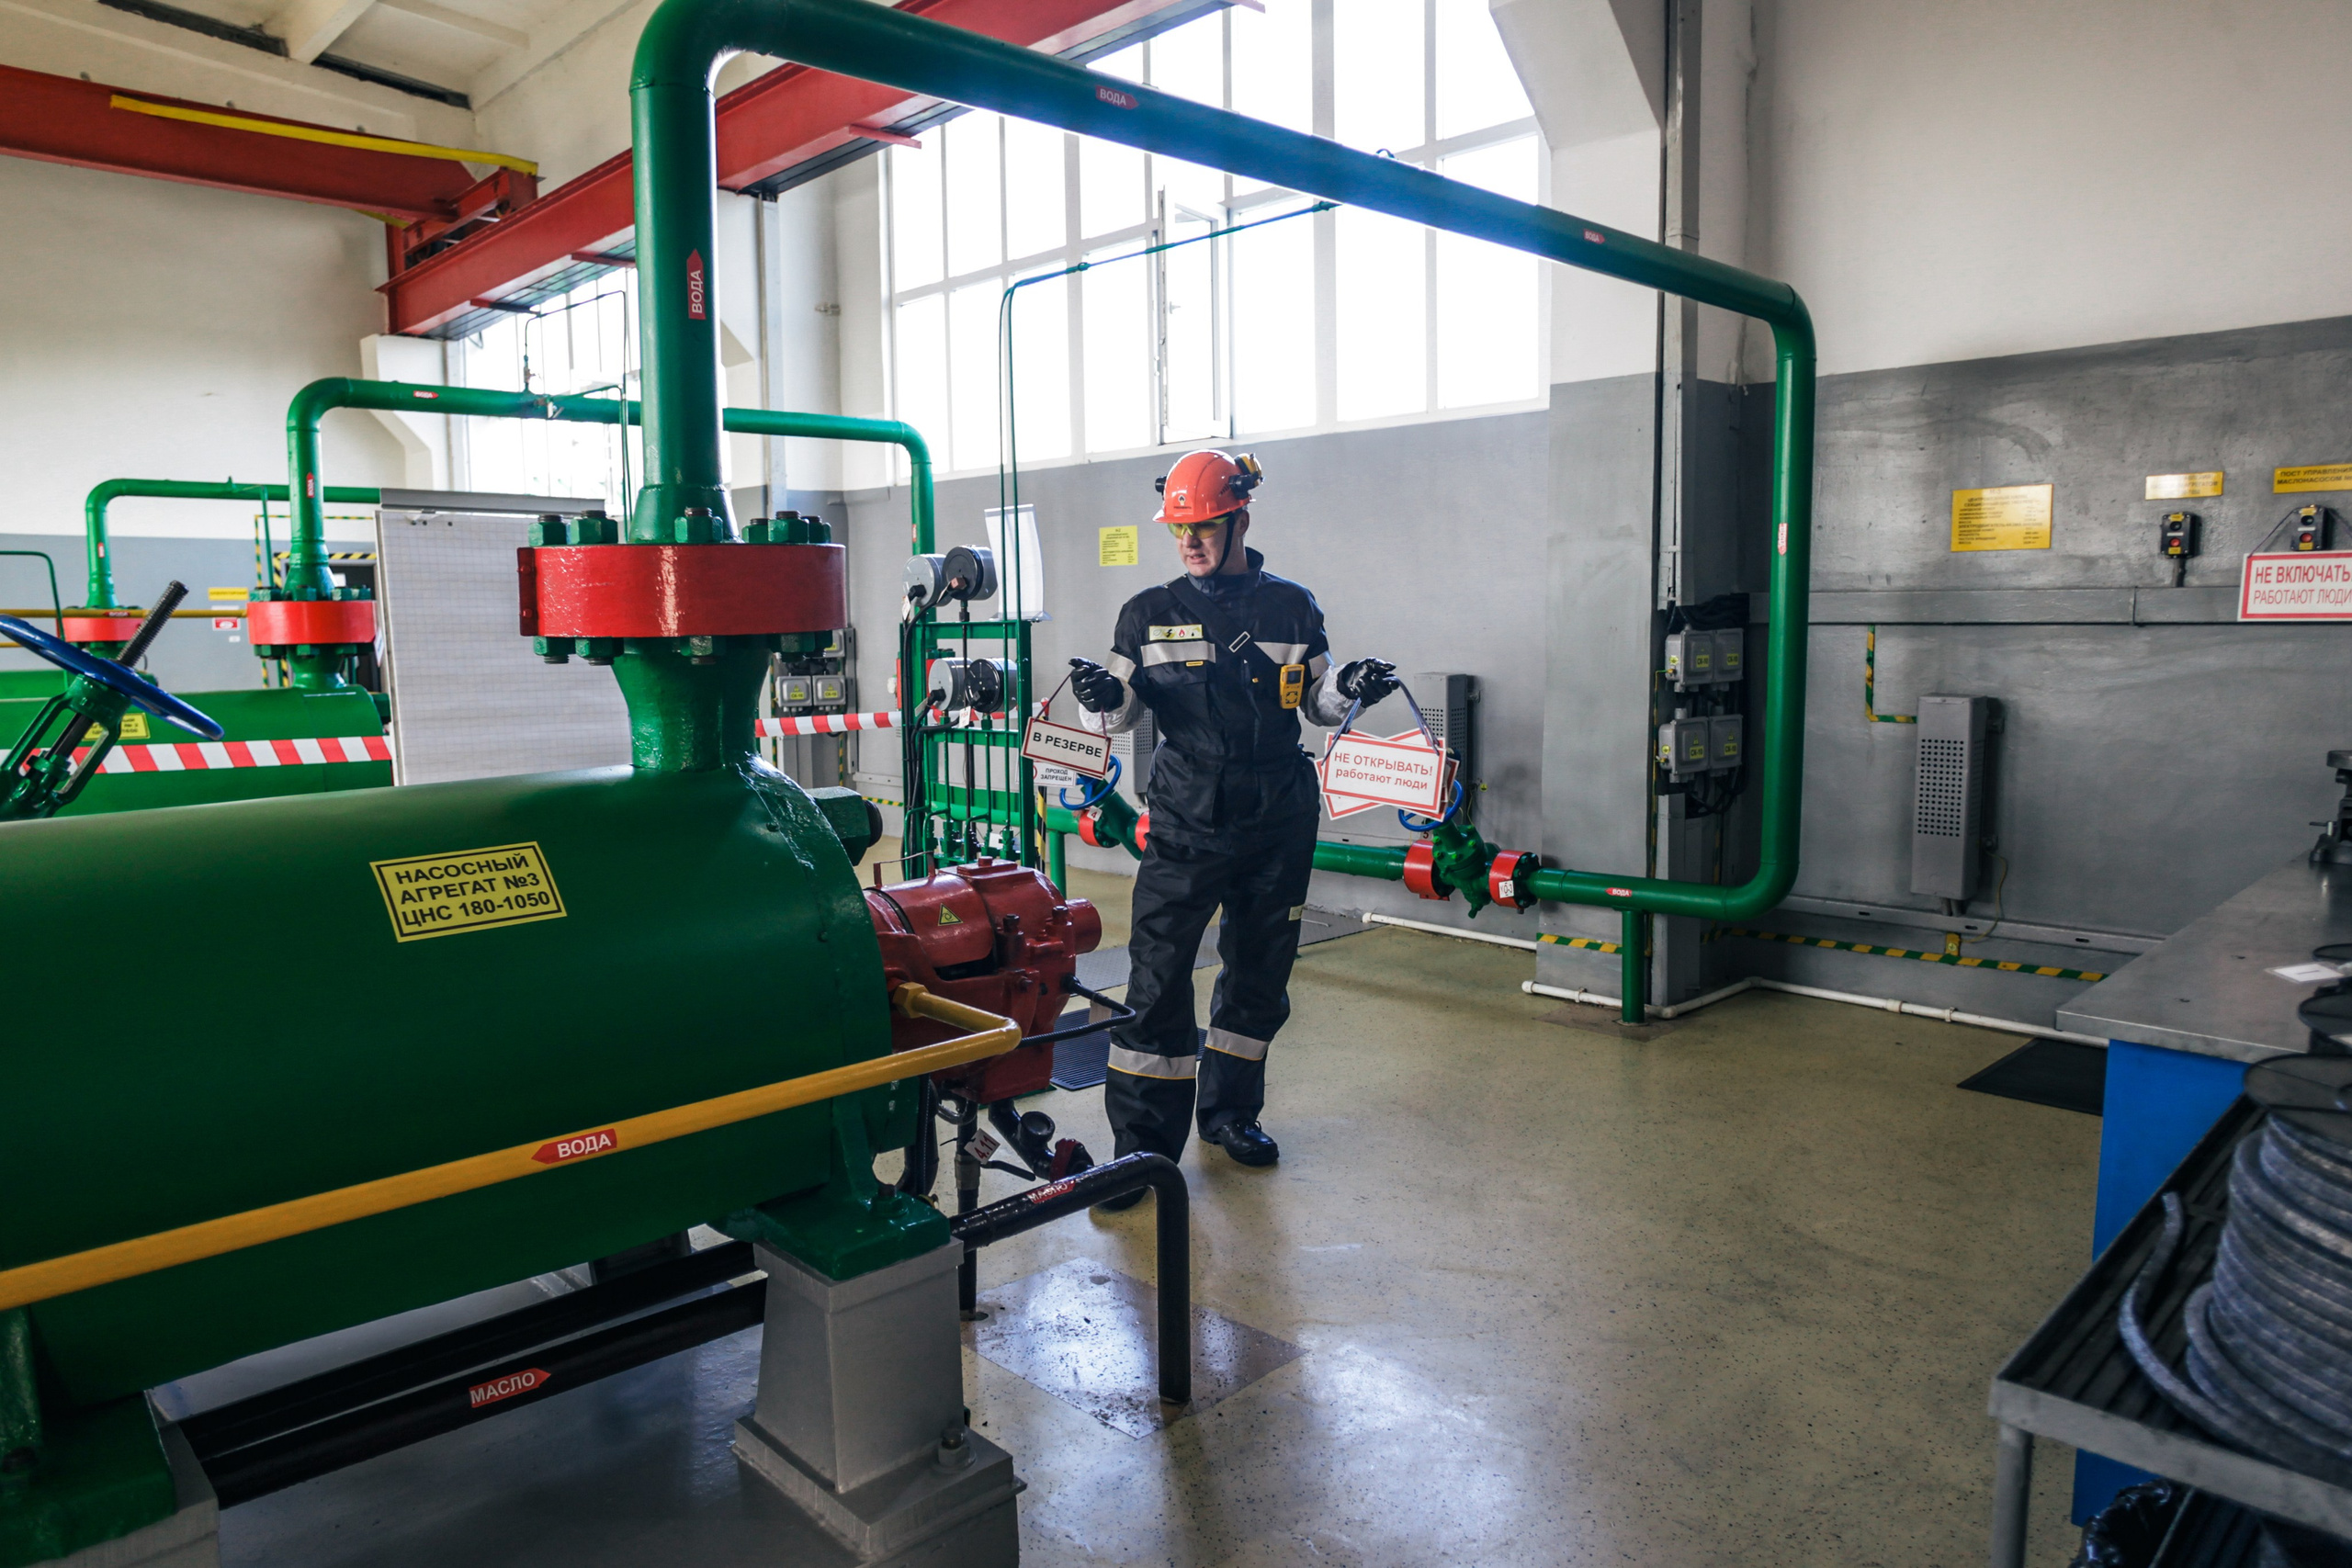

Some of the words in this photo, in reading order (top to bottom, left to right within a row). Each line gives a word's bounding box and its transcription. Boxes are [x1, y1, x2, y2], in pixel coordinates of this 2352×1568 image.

[1100, 88, 1126, 106] ВОДА
[690, 270, 703, 314] ВОДА
[2277, 476, 2343, 485] МАСЛОНАСОСОМ
[2255, 566, 2273, 583] НЕ
[2253, 589, 2315, 604] РАБОТАЮТ
[2316, 589, 2352, 606] ЛЮДИ
[1033, 732, 1042, 742] В
[1045, 735, 1102, 758] РЕЗЕРВЕ
[1334, 751, 1351, 763] НЕ
[1353, 754, 1433, 776] ОТКРЫВАТЬ!
[1335, 769, 1392, 784] работают
[1394, 777, 1428, 791] люди
[1423, 830, 1430, 840] 5
[394, 852, 529, 885] НАСОСНЫЙ
[401, 877, 497, 905] АГРЕГАТ
[503, 873, 540, 890] №3
[1612, 888, 1630, 897] ВОДА
[401, 905, 453, 928] ЦНС
[458, 891, 550, 918] 180-1050
[557, 1133, 612, 1158] ВОДА
[974, 1134, 998, 1159] 4.11
[1026, 1183, 1069, 1201] МАСЛО
[469, 1372, 536, 1404] МАСЛО
